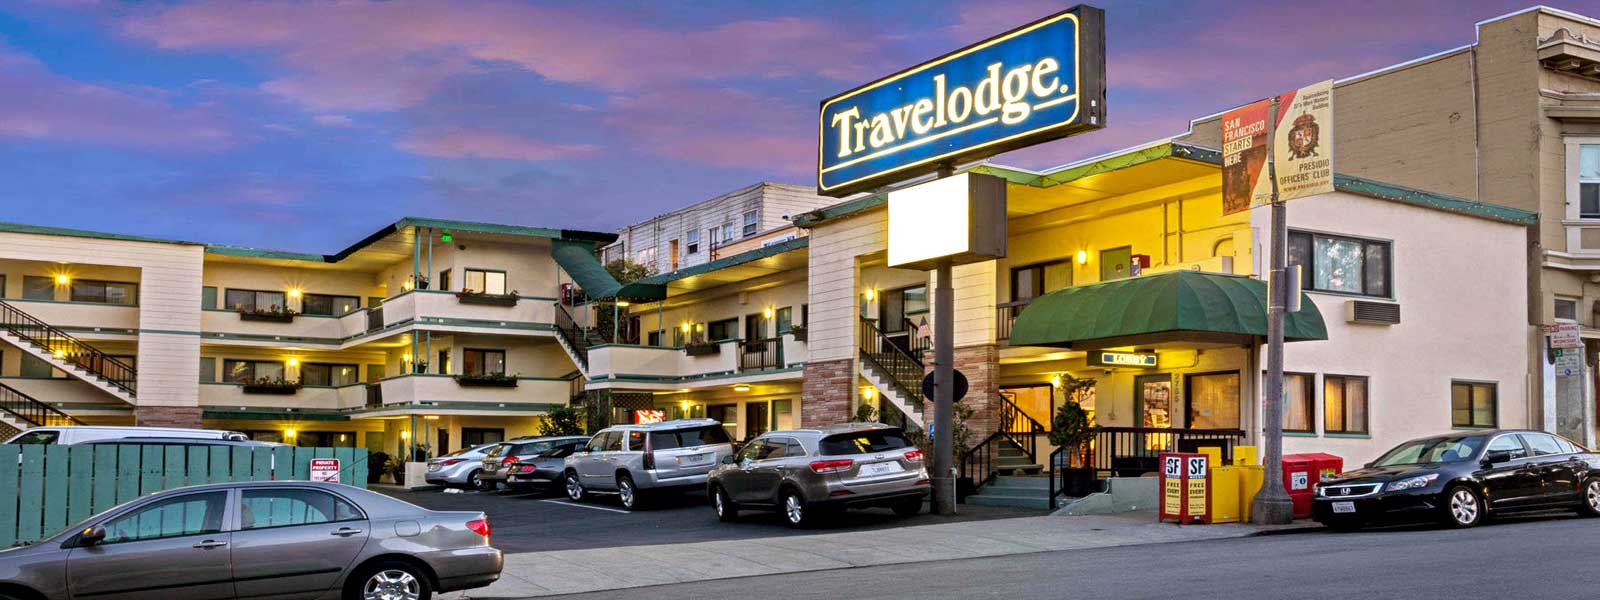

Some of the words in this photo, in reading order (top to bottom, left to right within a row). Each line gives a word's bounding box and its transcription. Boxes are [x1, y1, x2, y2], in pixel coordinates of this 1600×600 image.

[1225, 117, 1240, 131] SAN
[1225, 120, 1264, 142] FRANCISCO
[1225, 136, 1252, 155] STARTS
[1225, 152, 1241, 167] HERE
[1299, 159, 1329, 172] PRESIDIO
[1313, 169, 1329, 179] CLUB
[1113, 354, 1147, 365] LOBBY
[1167, 458, 1180, 474] SF
[1190, 459, 1205, 474] SF
